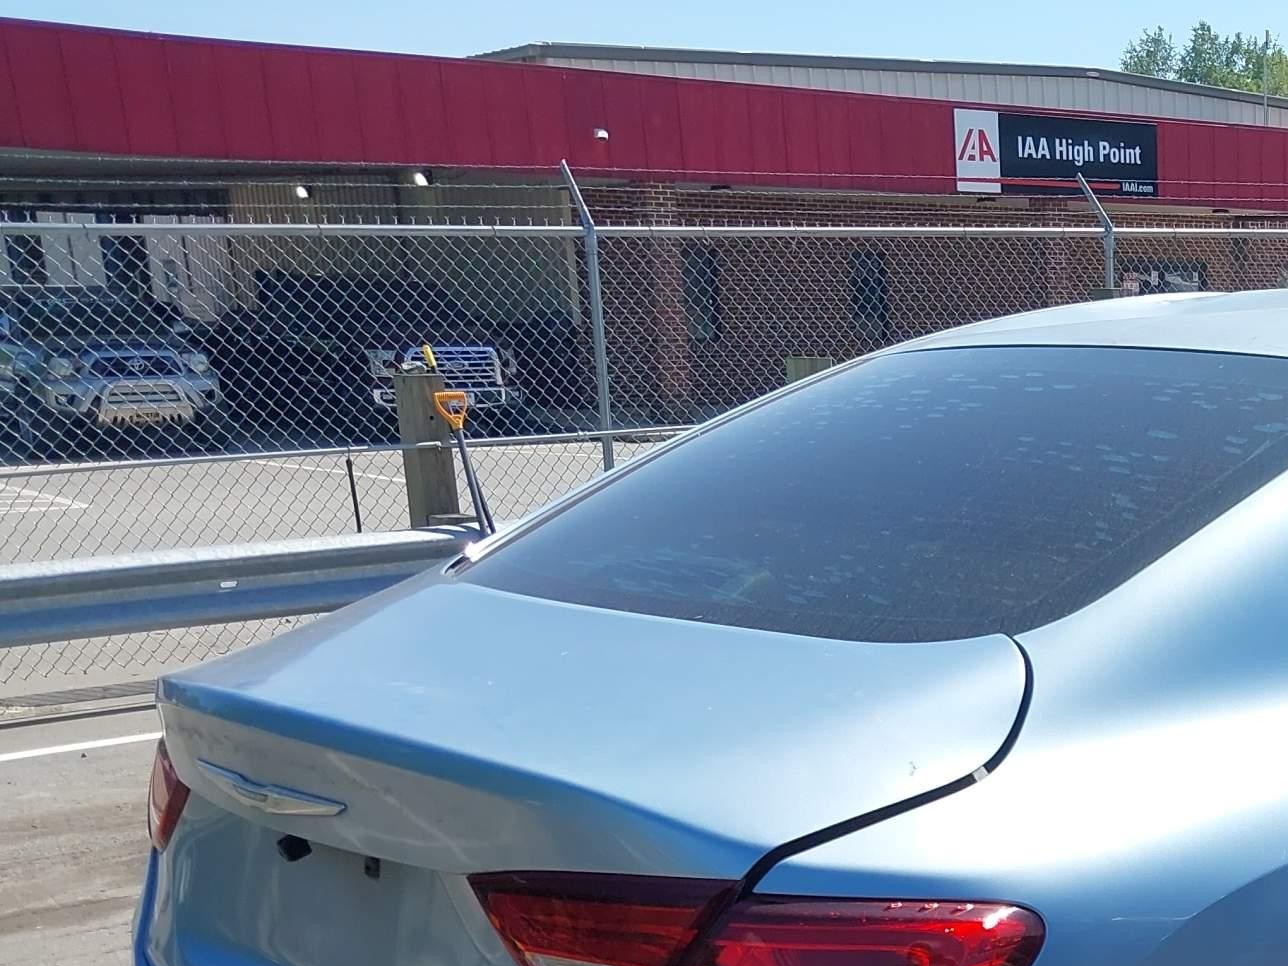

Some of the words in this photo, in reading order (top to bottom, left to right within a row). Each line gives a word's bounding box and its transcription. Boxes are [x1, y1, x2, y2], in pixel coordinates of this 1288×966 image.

[1017, 135, 1051, 160] IAA
[1054, 138, 1095, 167] High
[1099, 141, 1142, 165] Point
